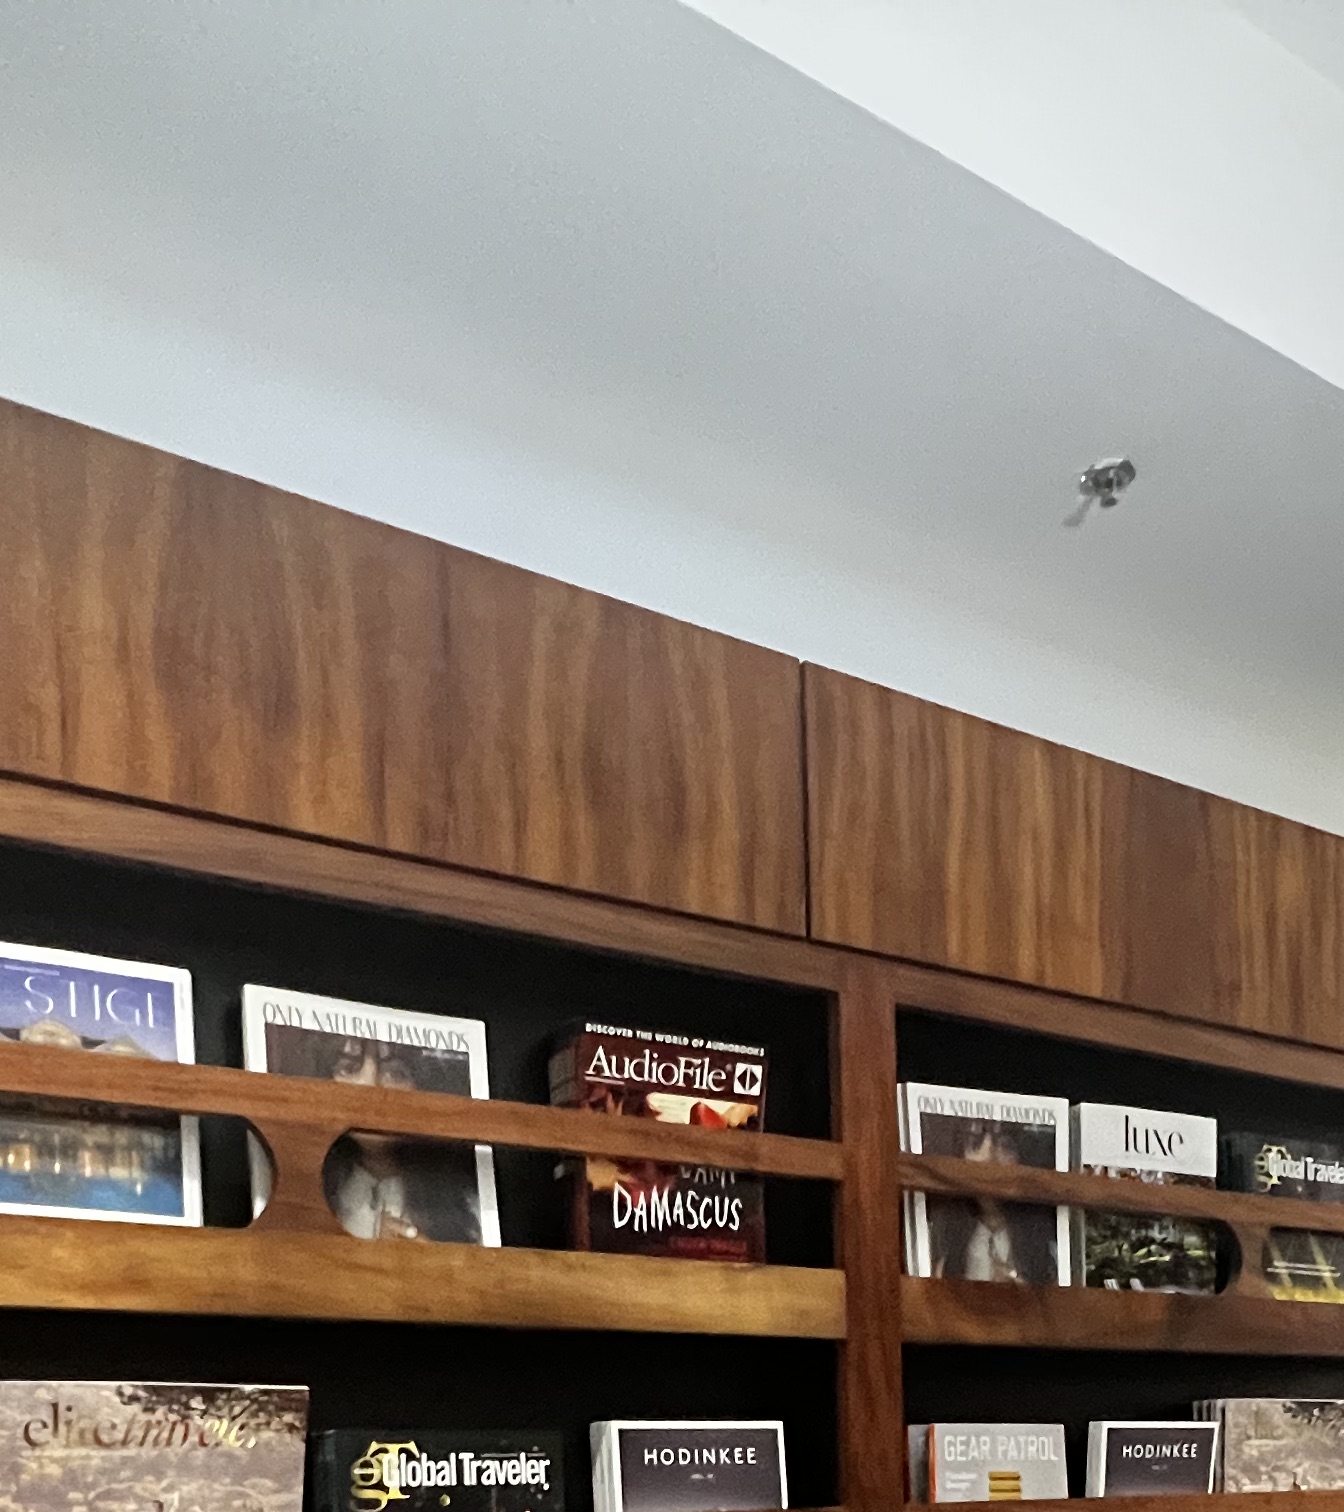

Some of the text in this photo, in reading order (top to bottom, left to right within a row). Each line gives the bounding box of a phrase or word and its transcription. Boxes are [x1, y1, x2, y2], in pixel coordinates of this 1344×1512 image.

[262, 1001, 470, 1051] ONLY NATURAL DIAMONDS
[585, 1022, 765, 1058] DISCOVER THE WORLD OF AUDIOBOOKS
[584, 1044, 727, 1092] AudioFile
[1124, 1114, 1185, 1158] luxe
[1268, 1154, 1305, 1180] Global
[613, 1181, 743, 1233] DAMASCUS
[643, 1446, 757, 1466] HODINKEE
[943, 1434, 1060, 1462] GEAR PATROL
[1122, 1441, 1198, 1460] HODINKEE
[382, 1451, 551, 1488] Global Traveler
